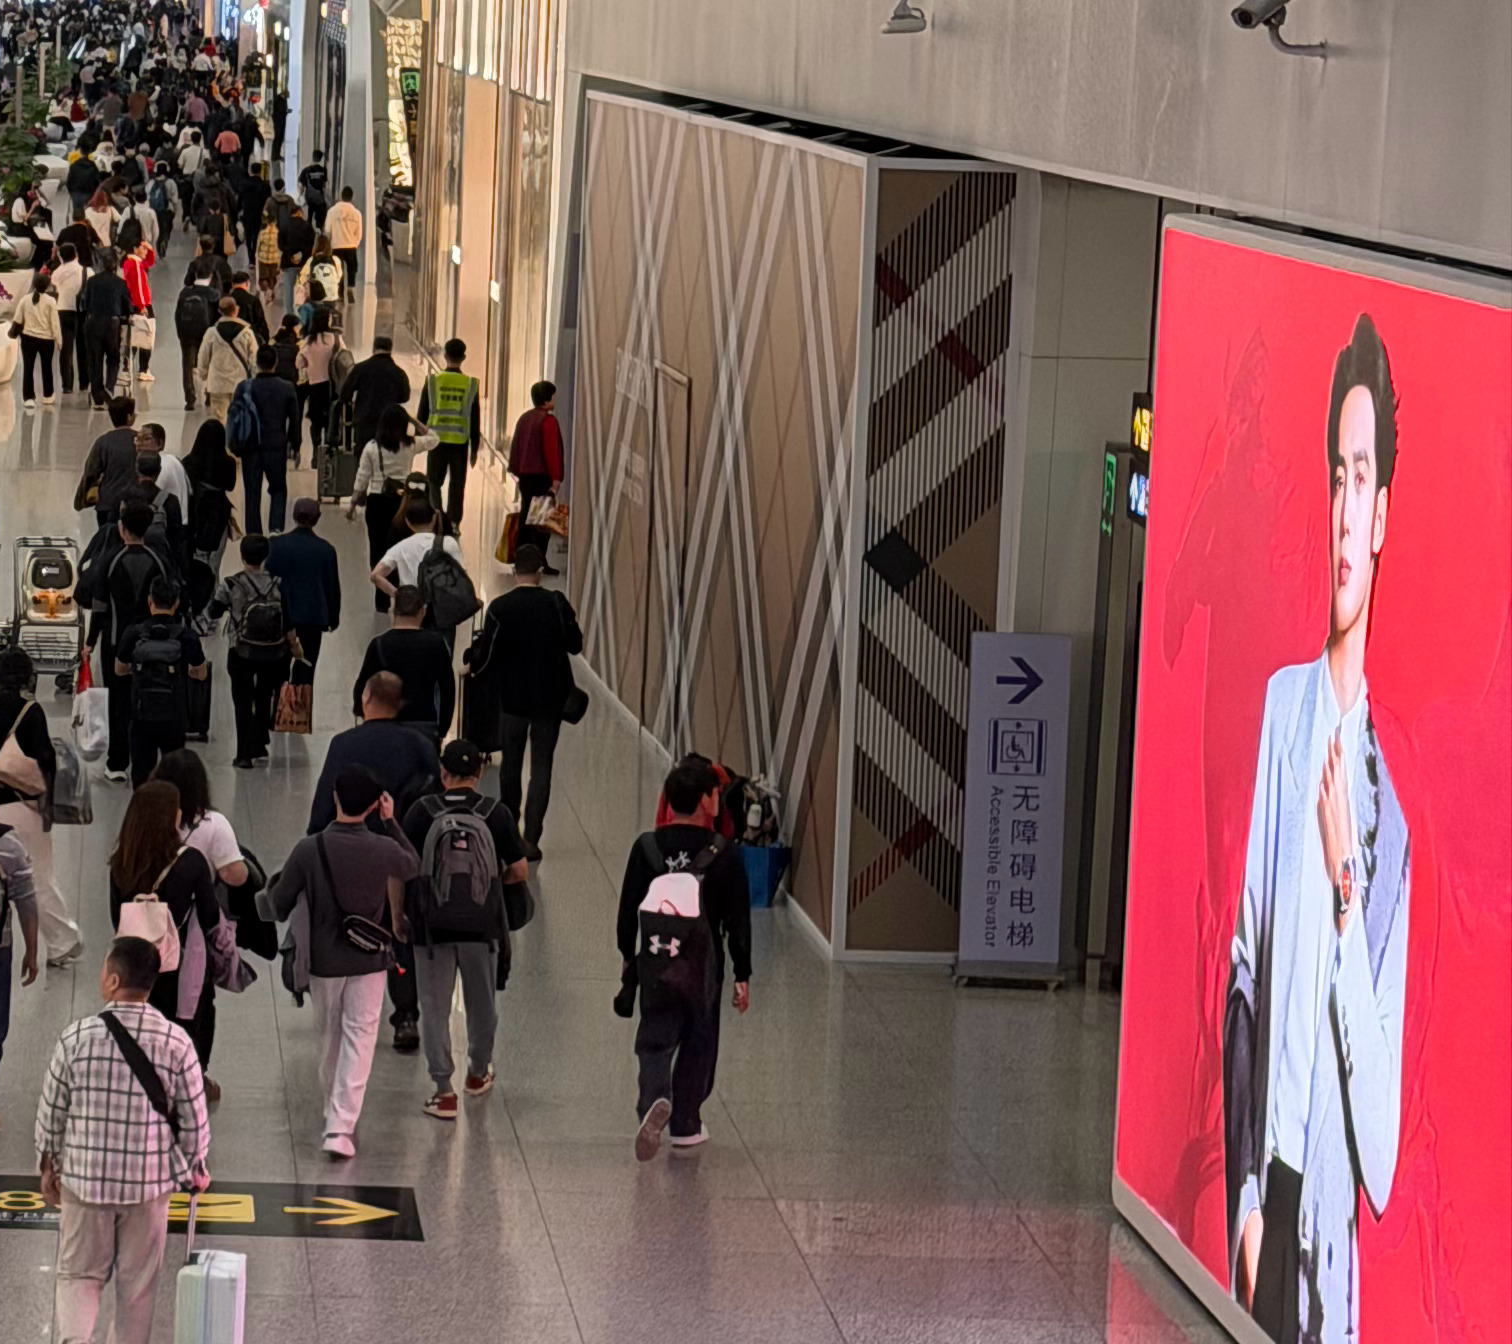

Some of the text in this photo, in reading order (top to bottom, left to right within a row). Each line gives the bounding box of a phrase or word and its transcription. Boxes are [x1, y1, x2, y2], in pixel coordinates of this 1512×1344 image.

[984, 785, 1004, 947] Accessible Elevator
[1006, 784, 1040, 949] 无障碍电梯
